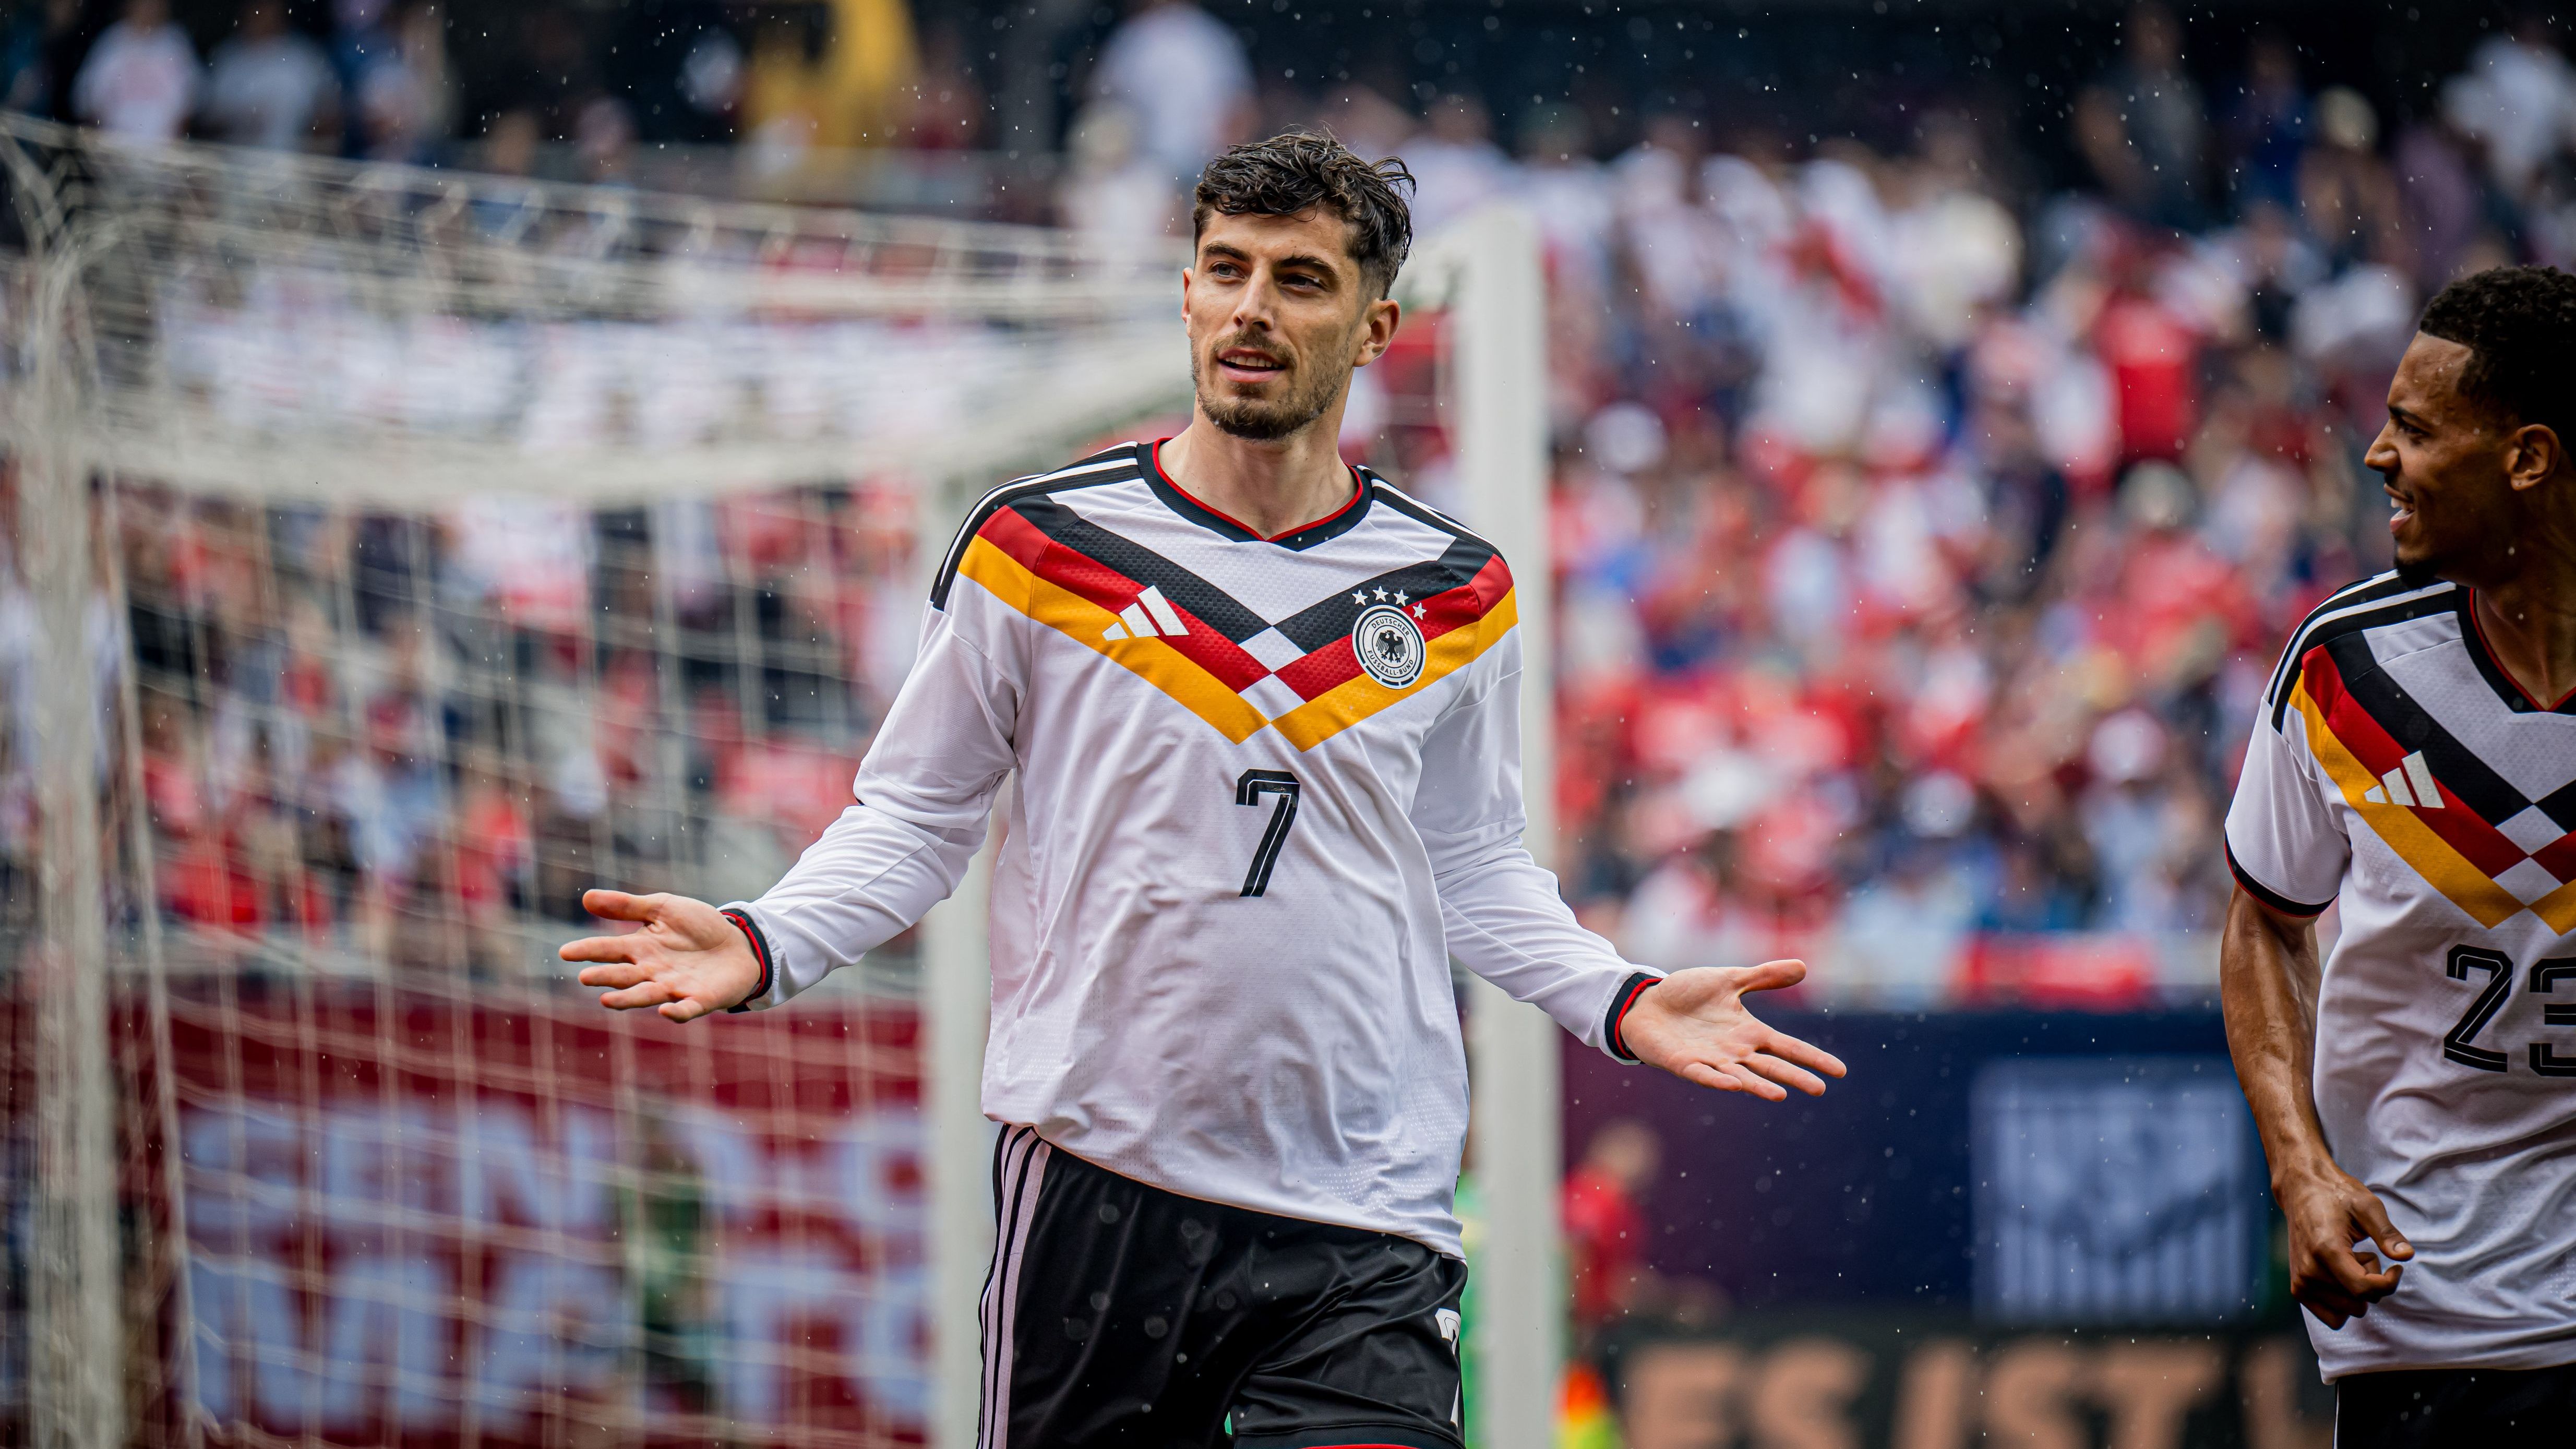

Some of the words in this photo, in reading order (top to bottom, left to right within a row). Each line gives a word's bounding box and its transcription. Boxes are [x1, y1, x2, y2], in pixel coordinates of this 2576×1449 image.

[1367, 650, 1413, 675] FUSSBALL-BUND
[1372, 618, 1410, 636] DEUTSCHER
[1236, 768, 1300, 897] 7
[2443, 943, 2576, 1077] 23
